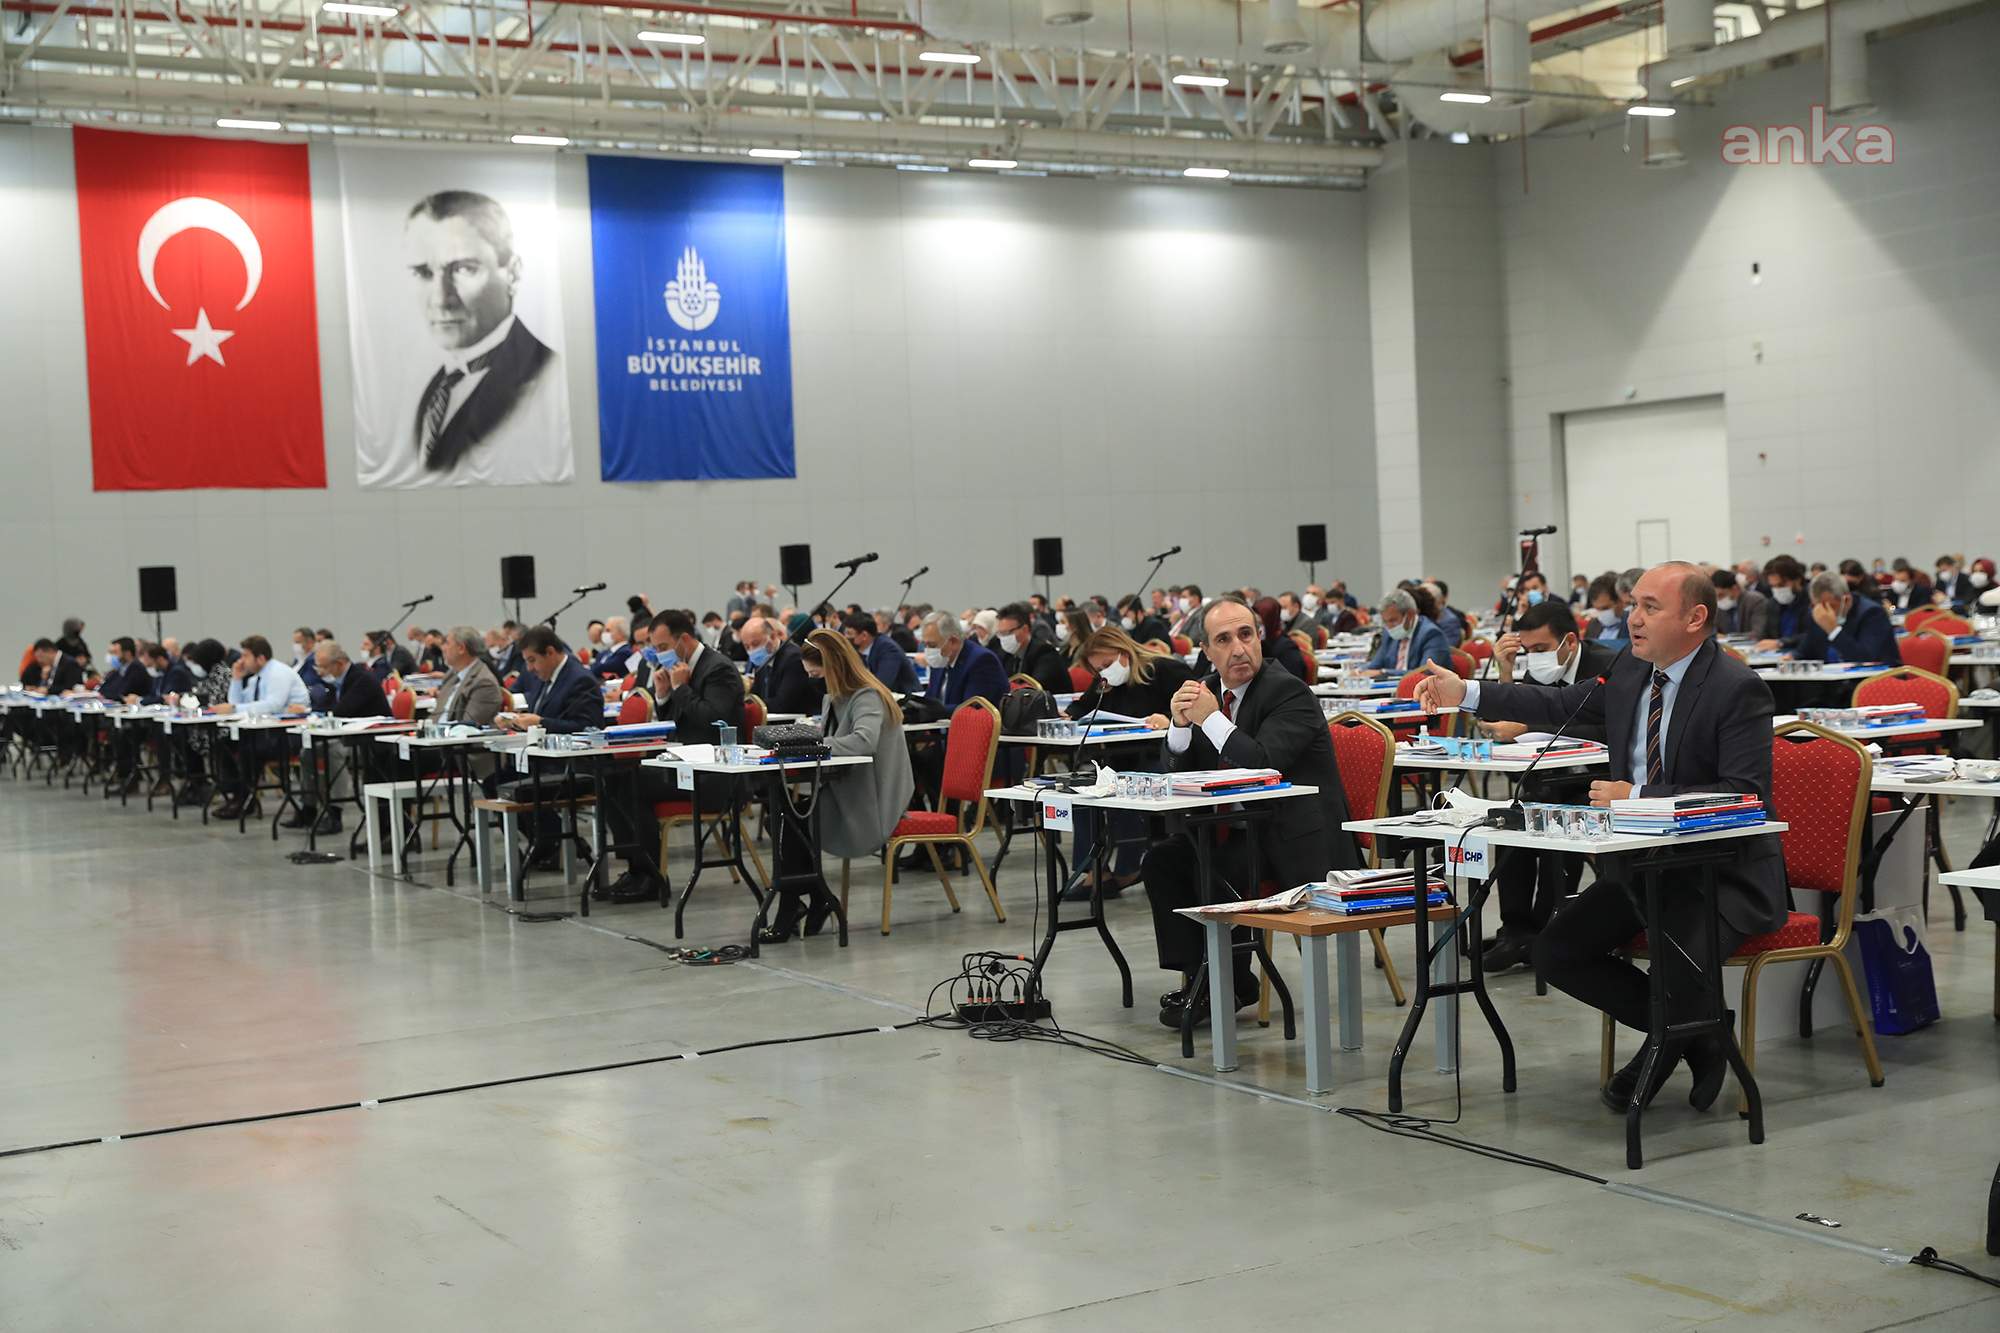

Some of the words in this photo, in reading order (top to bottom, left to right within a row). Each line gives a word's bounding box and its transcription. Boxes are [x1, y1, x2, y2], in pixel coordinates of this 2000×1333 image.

[647, 336, 741, 352] İSTANBUL
[627, 352, 762, 376] BÜYÜKŞEHİR
[650, 377, 743, 392] BELEDİYESİ
[1055, 808, 1069, 818] CHP
[1464, 850, 1483, 863] CHP
